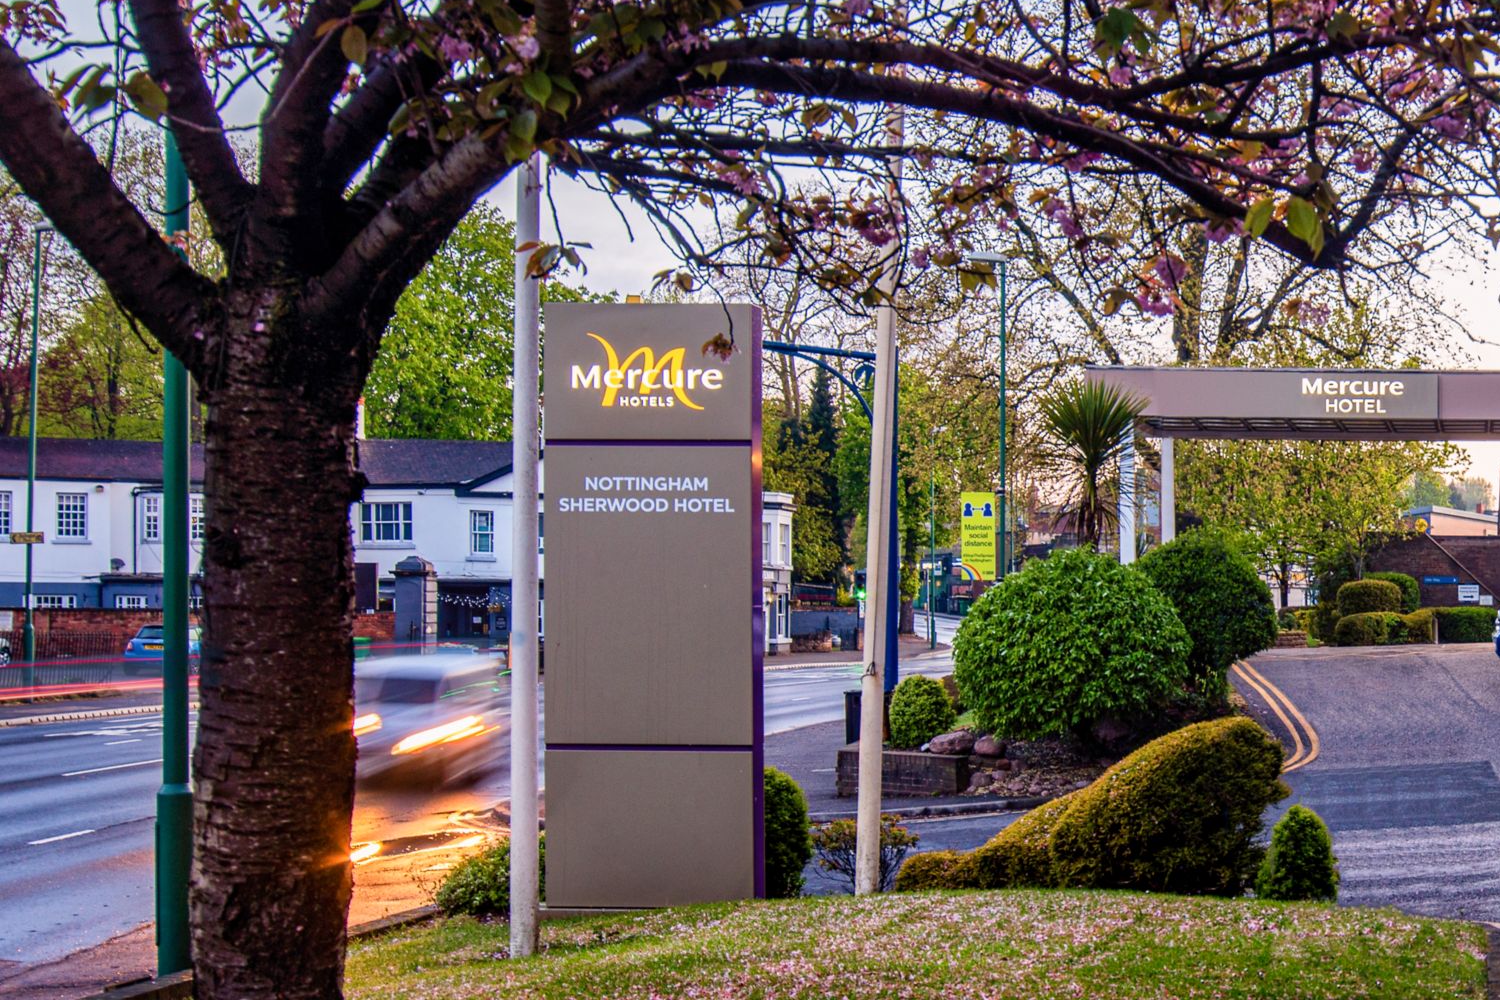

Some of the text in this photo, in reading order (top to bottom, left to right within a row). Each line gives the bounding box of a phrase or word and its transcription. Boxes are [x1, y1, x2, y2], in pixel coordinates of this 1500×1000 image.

[571, 364, 723, 390] Mercure
[1301, 377, 1405, 396] Mercure
[619, 396, 675, 407] HOTELS
[1325, 398, 1387, 414] HOTEL
[584, 476, 709, 492] NOTTINGHAM
[559, 497, 736, 513] SHERWOOD HOTEL
